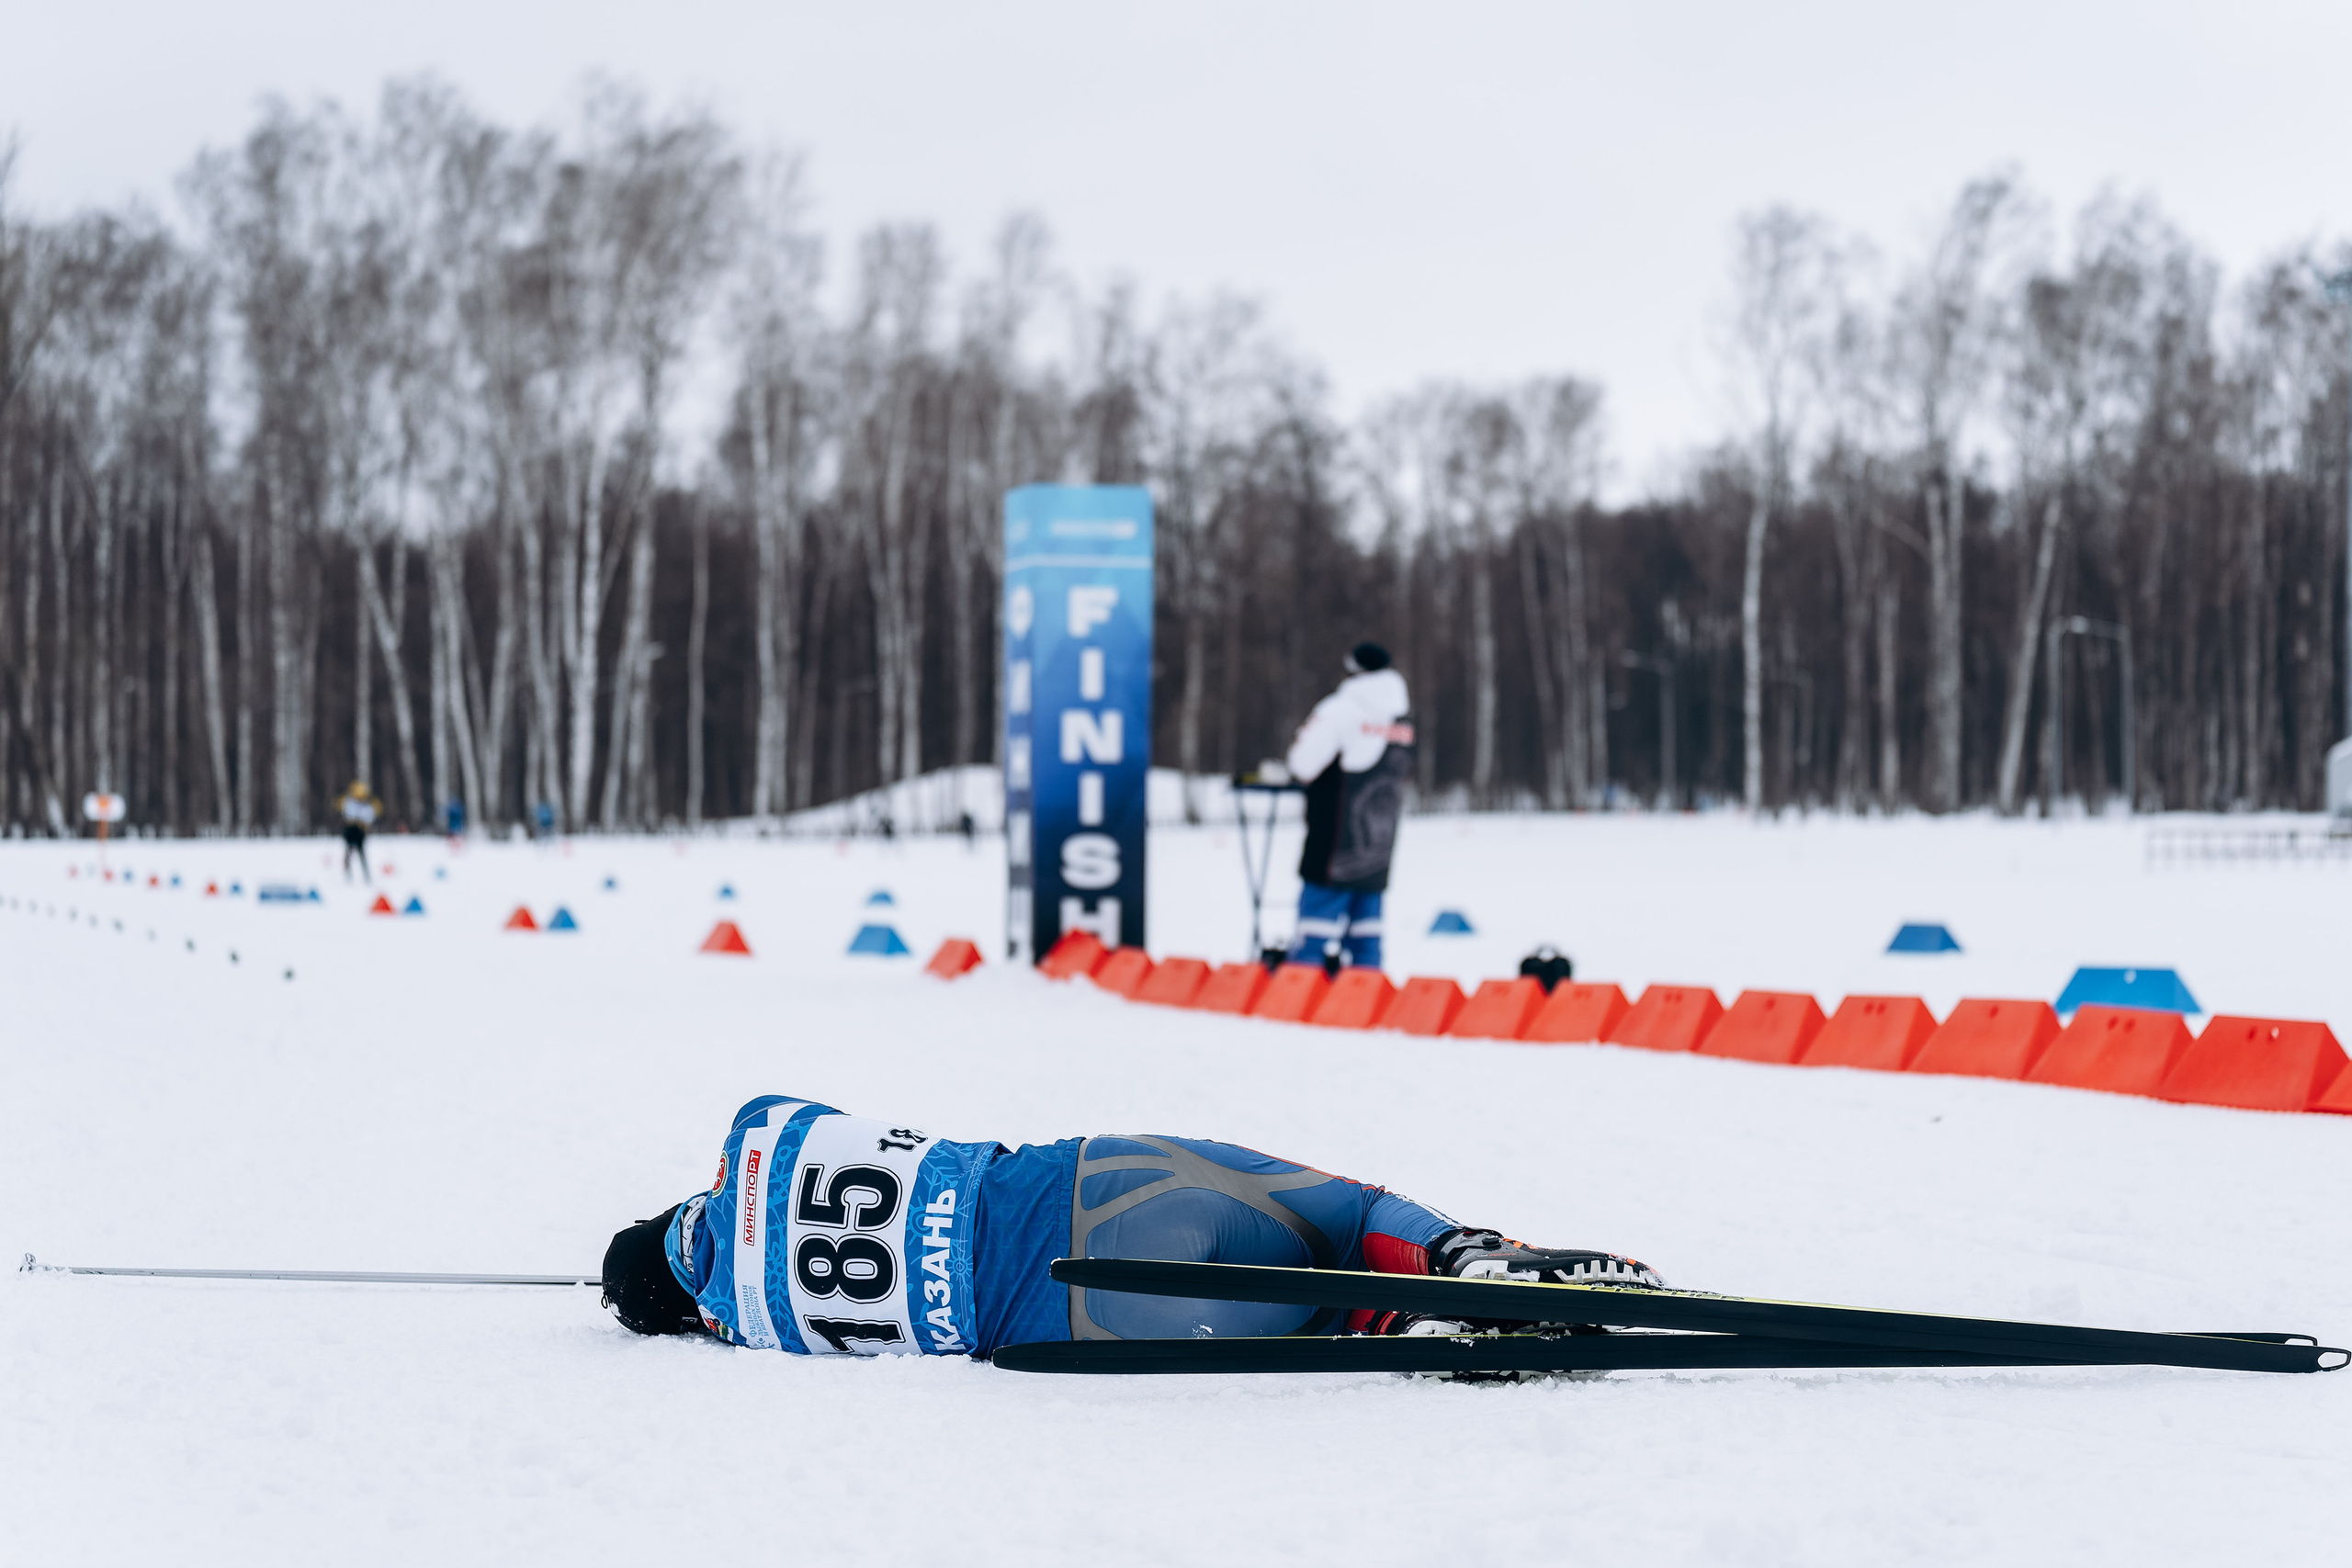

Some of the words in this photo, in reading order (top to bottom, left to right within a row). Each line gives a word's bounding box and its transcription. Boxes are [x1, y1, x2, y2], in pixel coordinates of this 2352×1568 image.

[1059, 585, 1124, 950] FINISH
[745, 1152, 760, 1243] МИНСПОРТ
[877, 1128, 928, 1153] 18
[742, 1284, 757, 1337] ФЕДЕРАЦИЯ
[794, 1164, 906, 1353] 185
[922, 1189, 966, 1351] КАЗАНЬ
